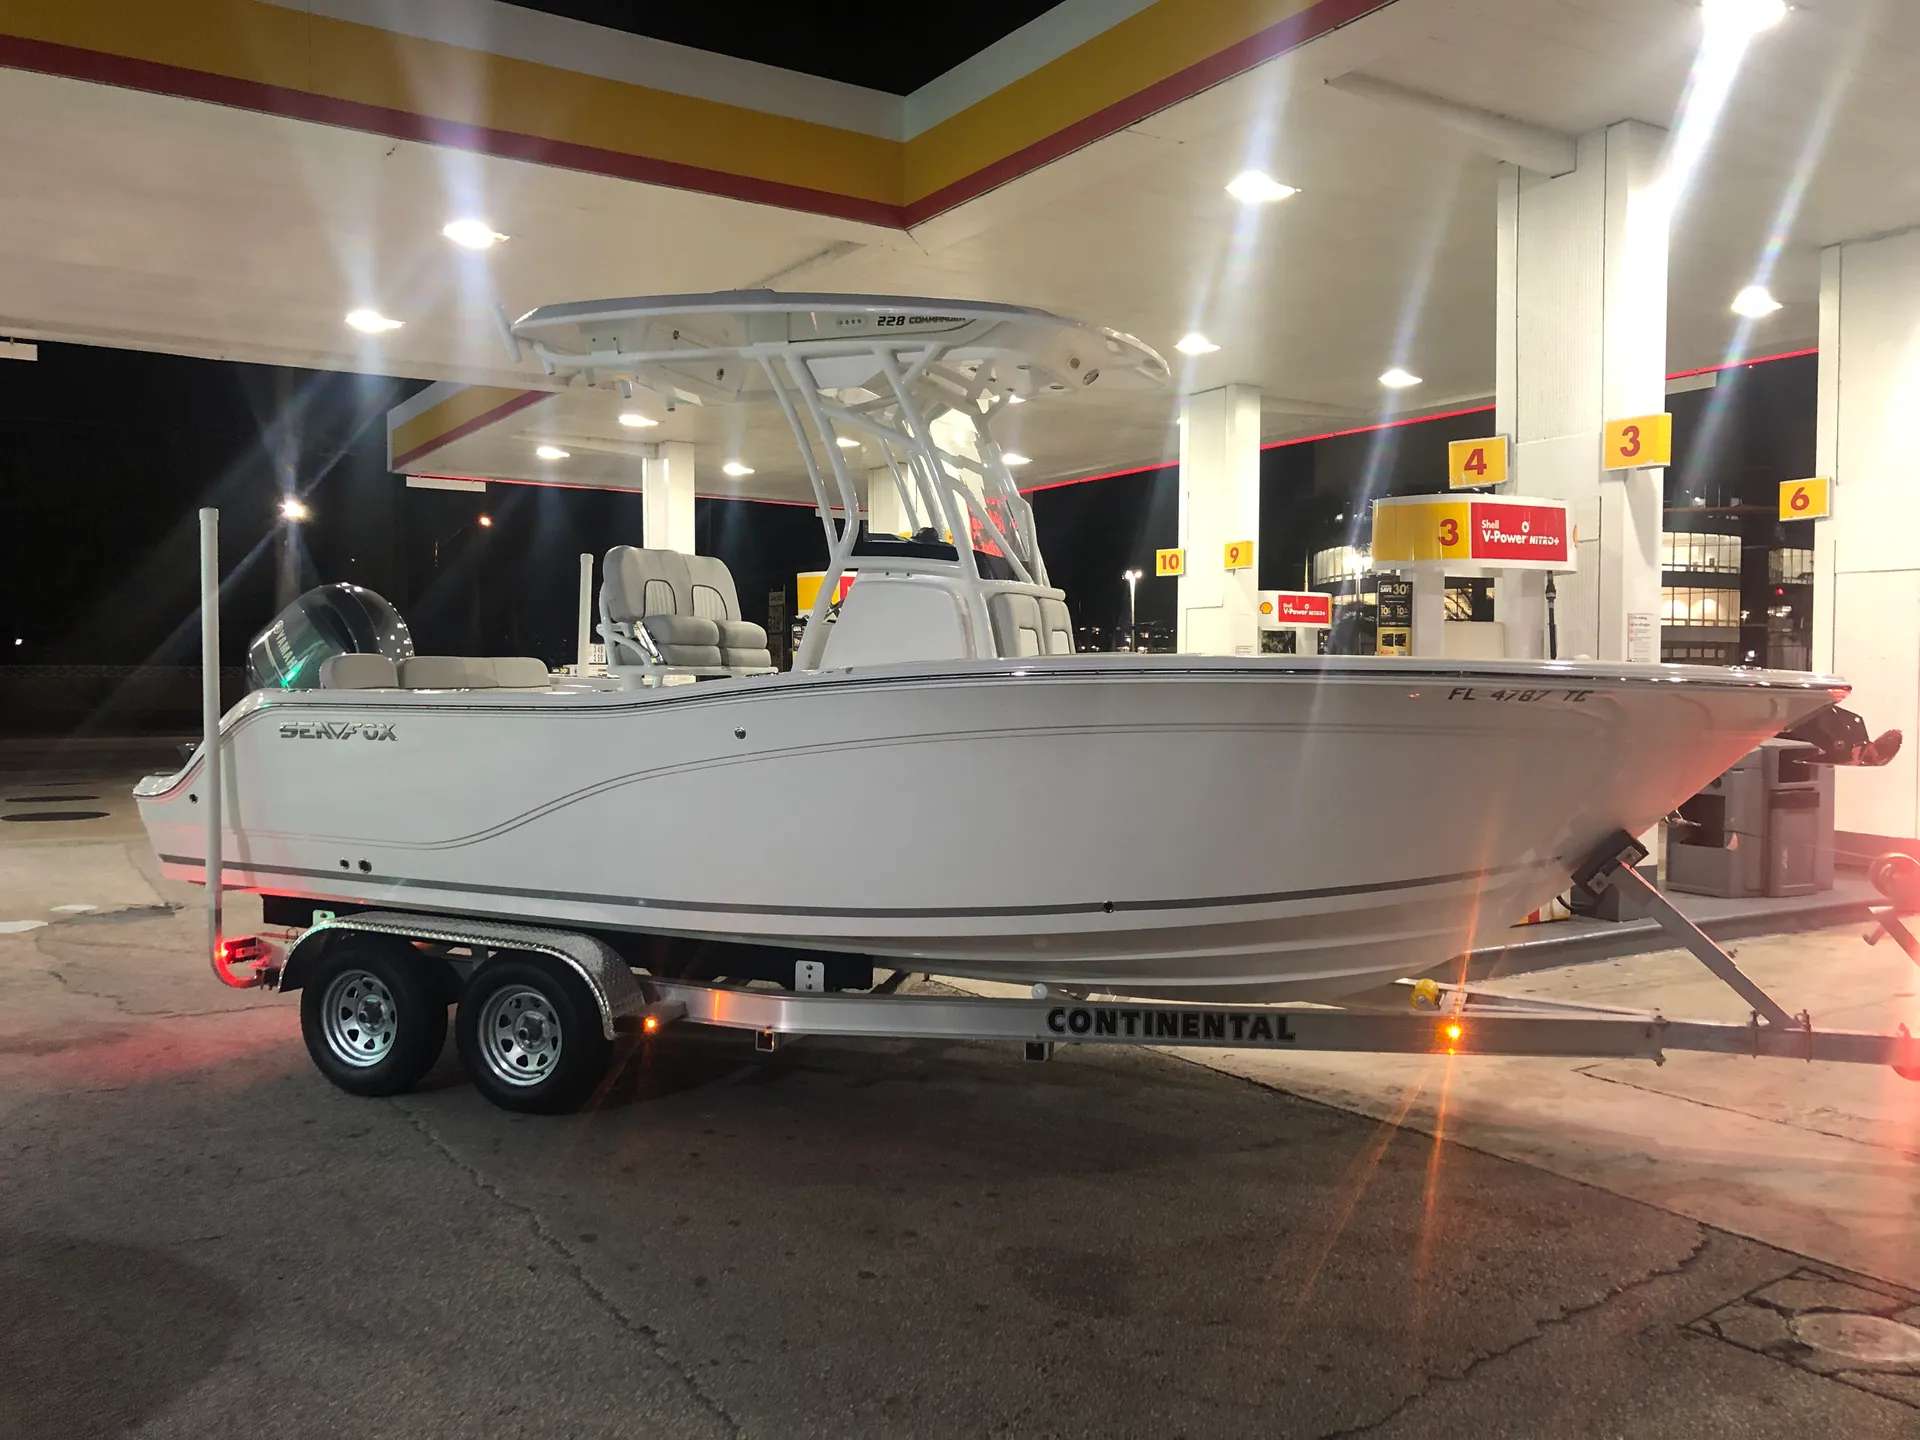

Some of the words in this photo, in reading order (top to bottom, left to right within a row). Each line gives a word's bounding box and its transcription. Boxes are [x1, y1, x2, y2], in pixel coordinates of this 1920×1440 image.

[877, 315, 905, 326] 228
[908, 315, 966, 324] COMMAN
[1620, 425, 1641, 457] 3
[1464, 448, 1487, 475] 4
[1790, 486, 1810, 511] 6
[1438, 518, 1459, 546] 3
[1481, 519, 1500, 530] Shell
[1482, 529, 1527, 544] V-Power
[1160, 553, 1179, 570] 10
[1229, 546, 1240, 564] 9
[1283, 608, 1308, 616] V-Power
[275, 629, 298, 670] YAMAH
[1448, 687, 1475, 701] FL
[1489, 688, 1552, 702] 4787
[1046, 1007, 1297, 1042] CONTINENTAL
